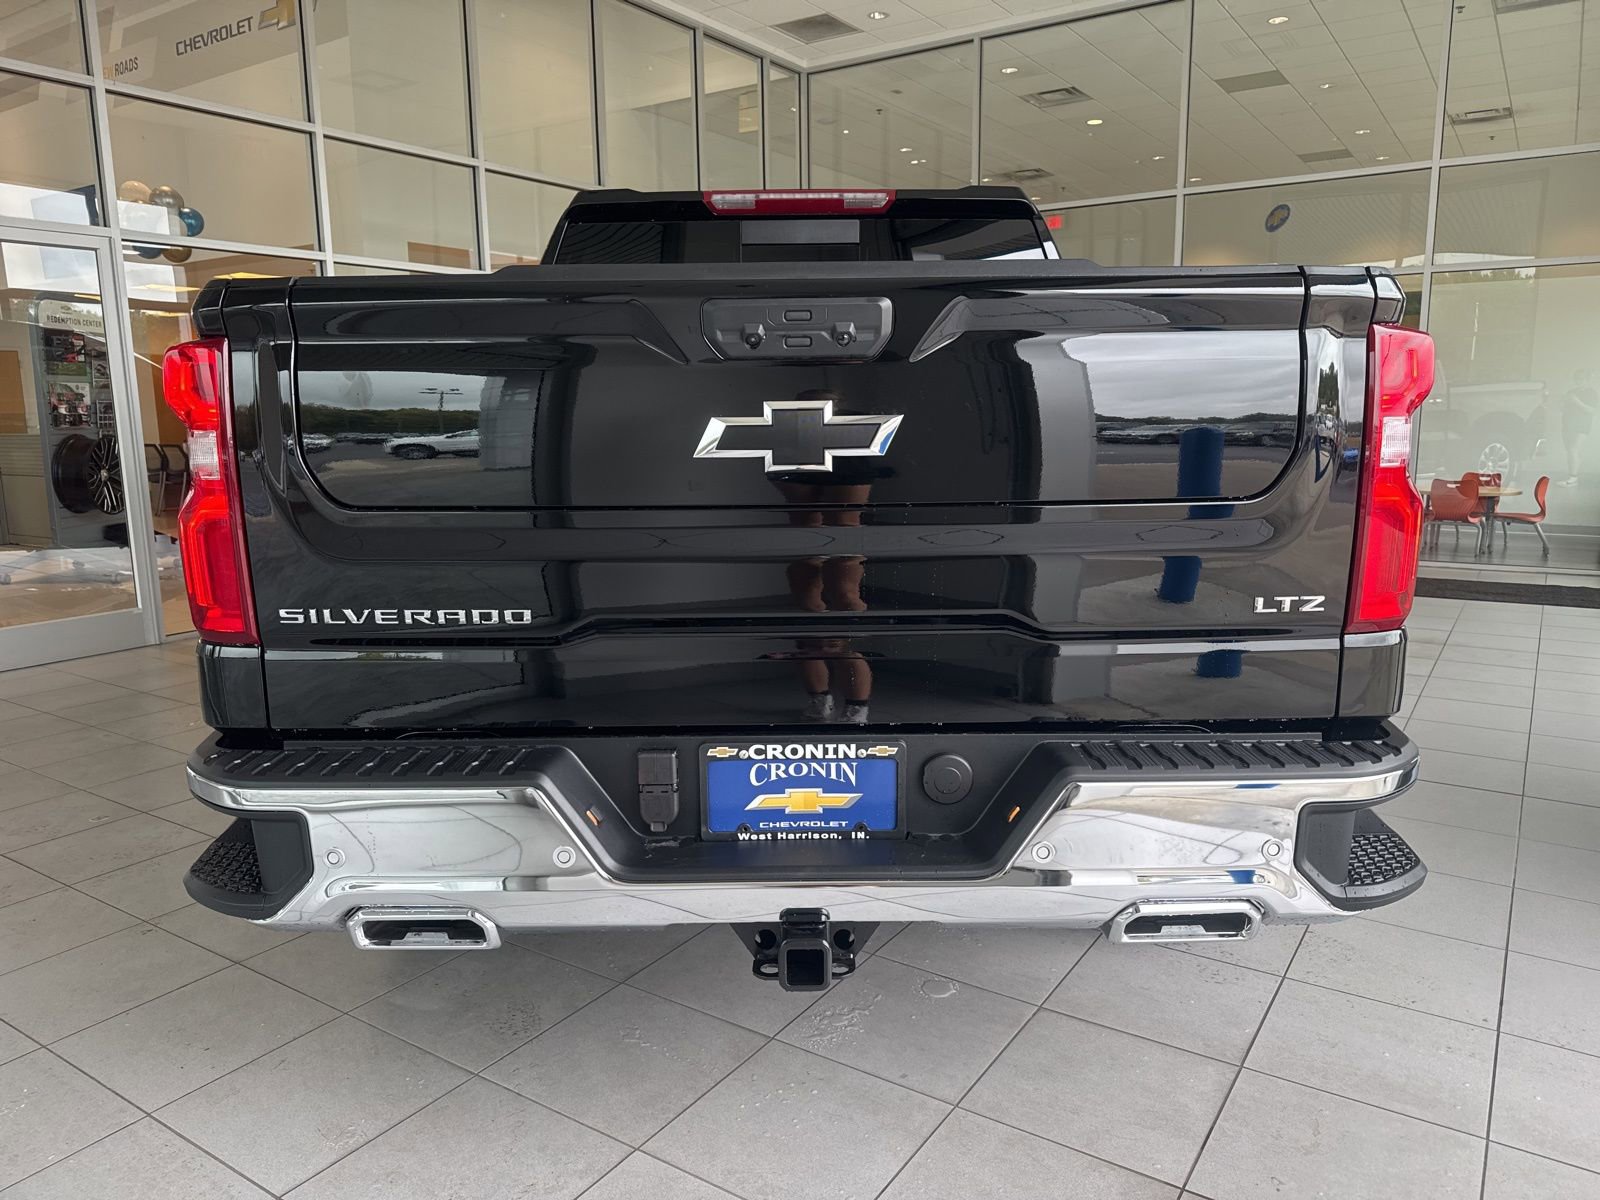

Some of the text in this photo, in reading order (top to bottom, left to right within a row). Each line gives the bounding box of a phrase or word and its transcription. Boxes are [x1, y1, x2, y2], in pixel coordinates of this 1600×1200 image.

[175, 16, 253, 56] CHEVROLET
[114, 56, 139, 77] ROADS
[46, 314, 102, 328] REDEMPTION CENTER
[1253, 595, 1326, 613] LTZ
[279, 608, 532, 625] SILVERADO
[749, 743, 856, 760] CRONIN
[750, 762, 858, 787] CRONIN
[759, 820, 849, 829] CHEVROLET
[737, 831, 870, 841] West Harrison, IN.
